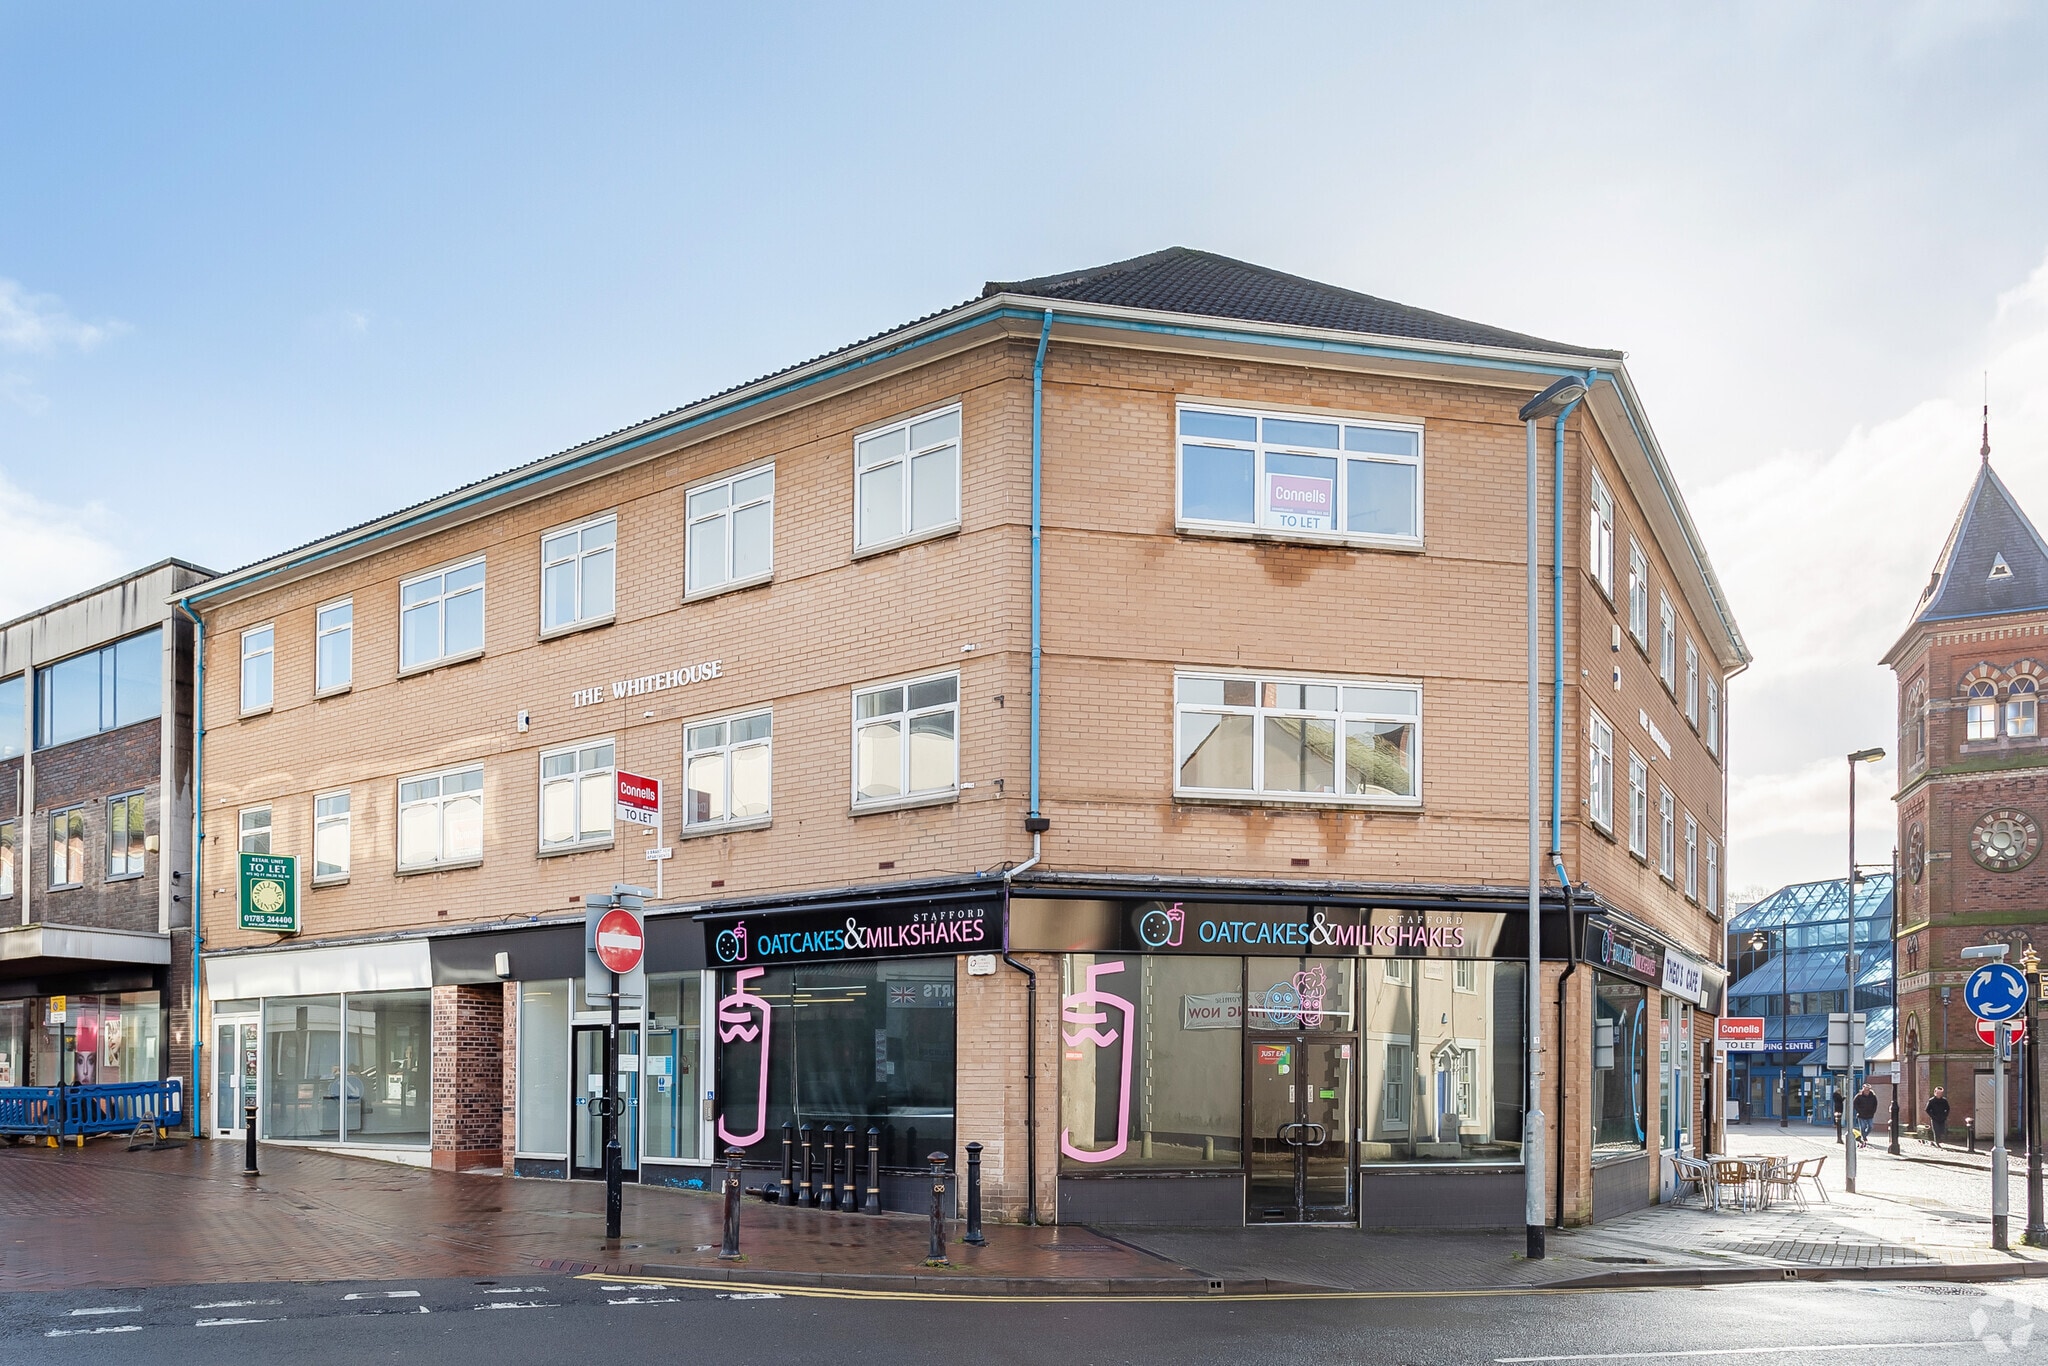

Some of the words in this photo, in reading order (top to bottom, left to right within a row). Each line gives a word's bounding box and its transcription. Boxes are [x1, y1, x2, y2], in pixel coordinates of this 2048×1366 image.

[1275, 486, 1326, 504] Connells
[1280, 514, 1297, 527] TO
[1300, 516, 1321, 529] LET
[572, 686, 604, 708] THE
[612, 659, 723, 700] WHITEHOUSE
[620, 781, 656, 801] Connells
[624, 808, 637, 821] TO
[638, 811, 653, 824] LET
[249, 863, 264, 872] TO
[269, 865, 287, 874] LET
[256, 898, 281, 911] SANDY
[913, 908, 984, 922] STAFFORD
[1388, 914, 1464, 925] STAFFORD
[1666, 958, 1684, 988] THEO'S
[1721, 1024, 1760, 1034] Connells
[1725, 1041, 1738, 1049] TO
[1740, 1041, 1756, 1049] LET
[1785, 1041, 1814, 1050] CENTRE
[1261, 1050, 1275, 1058] JUST
